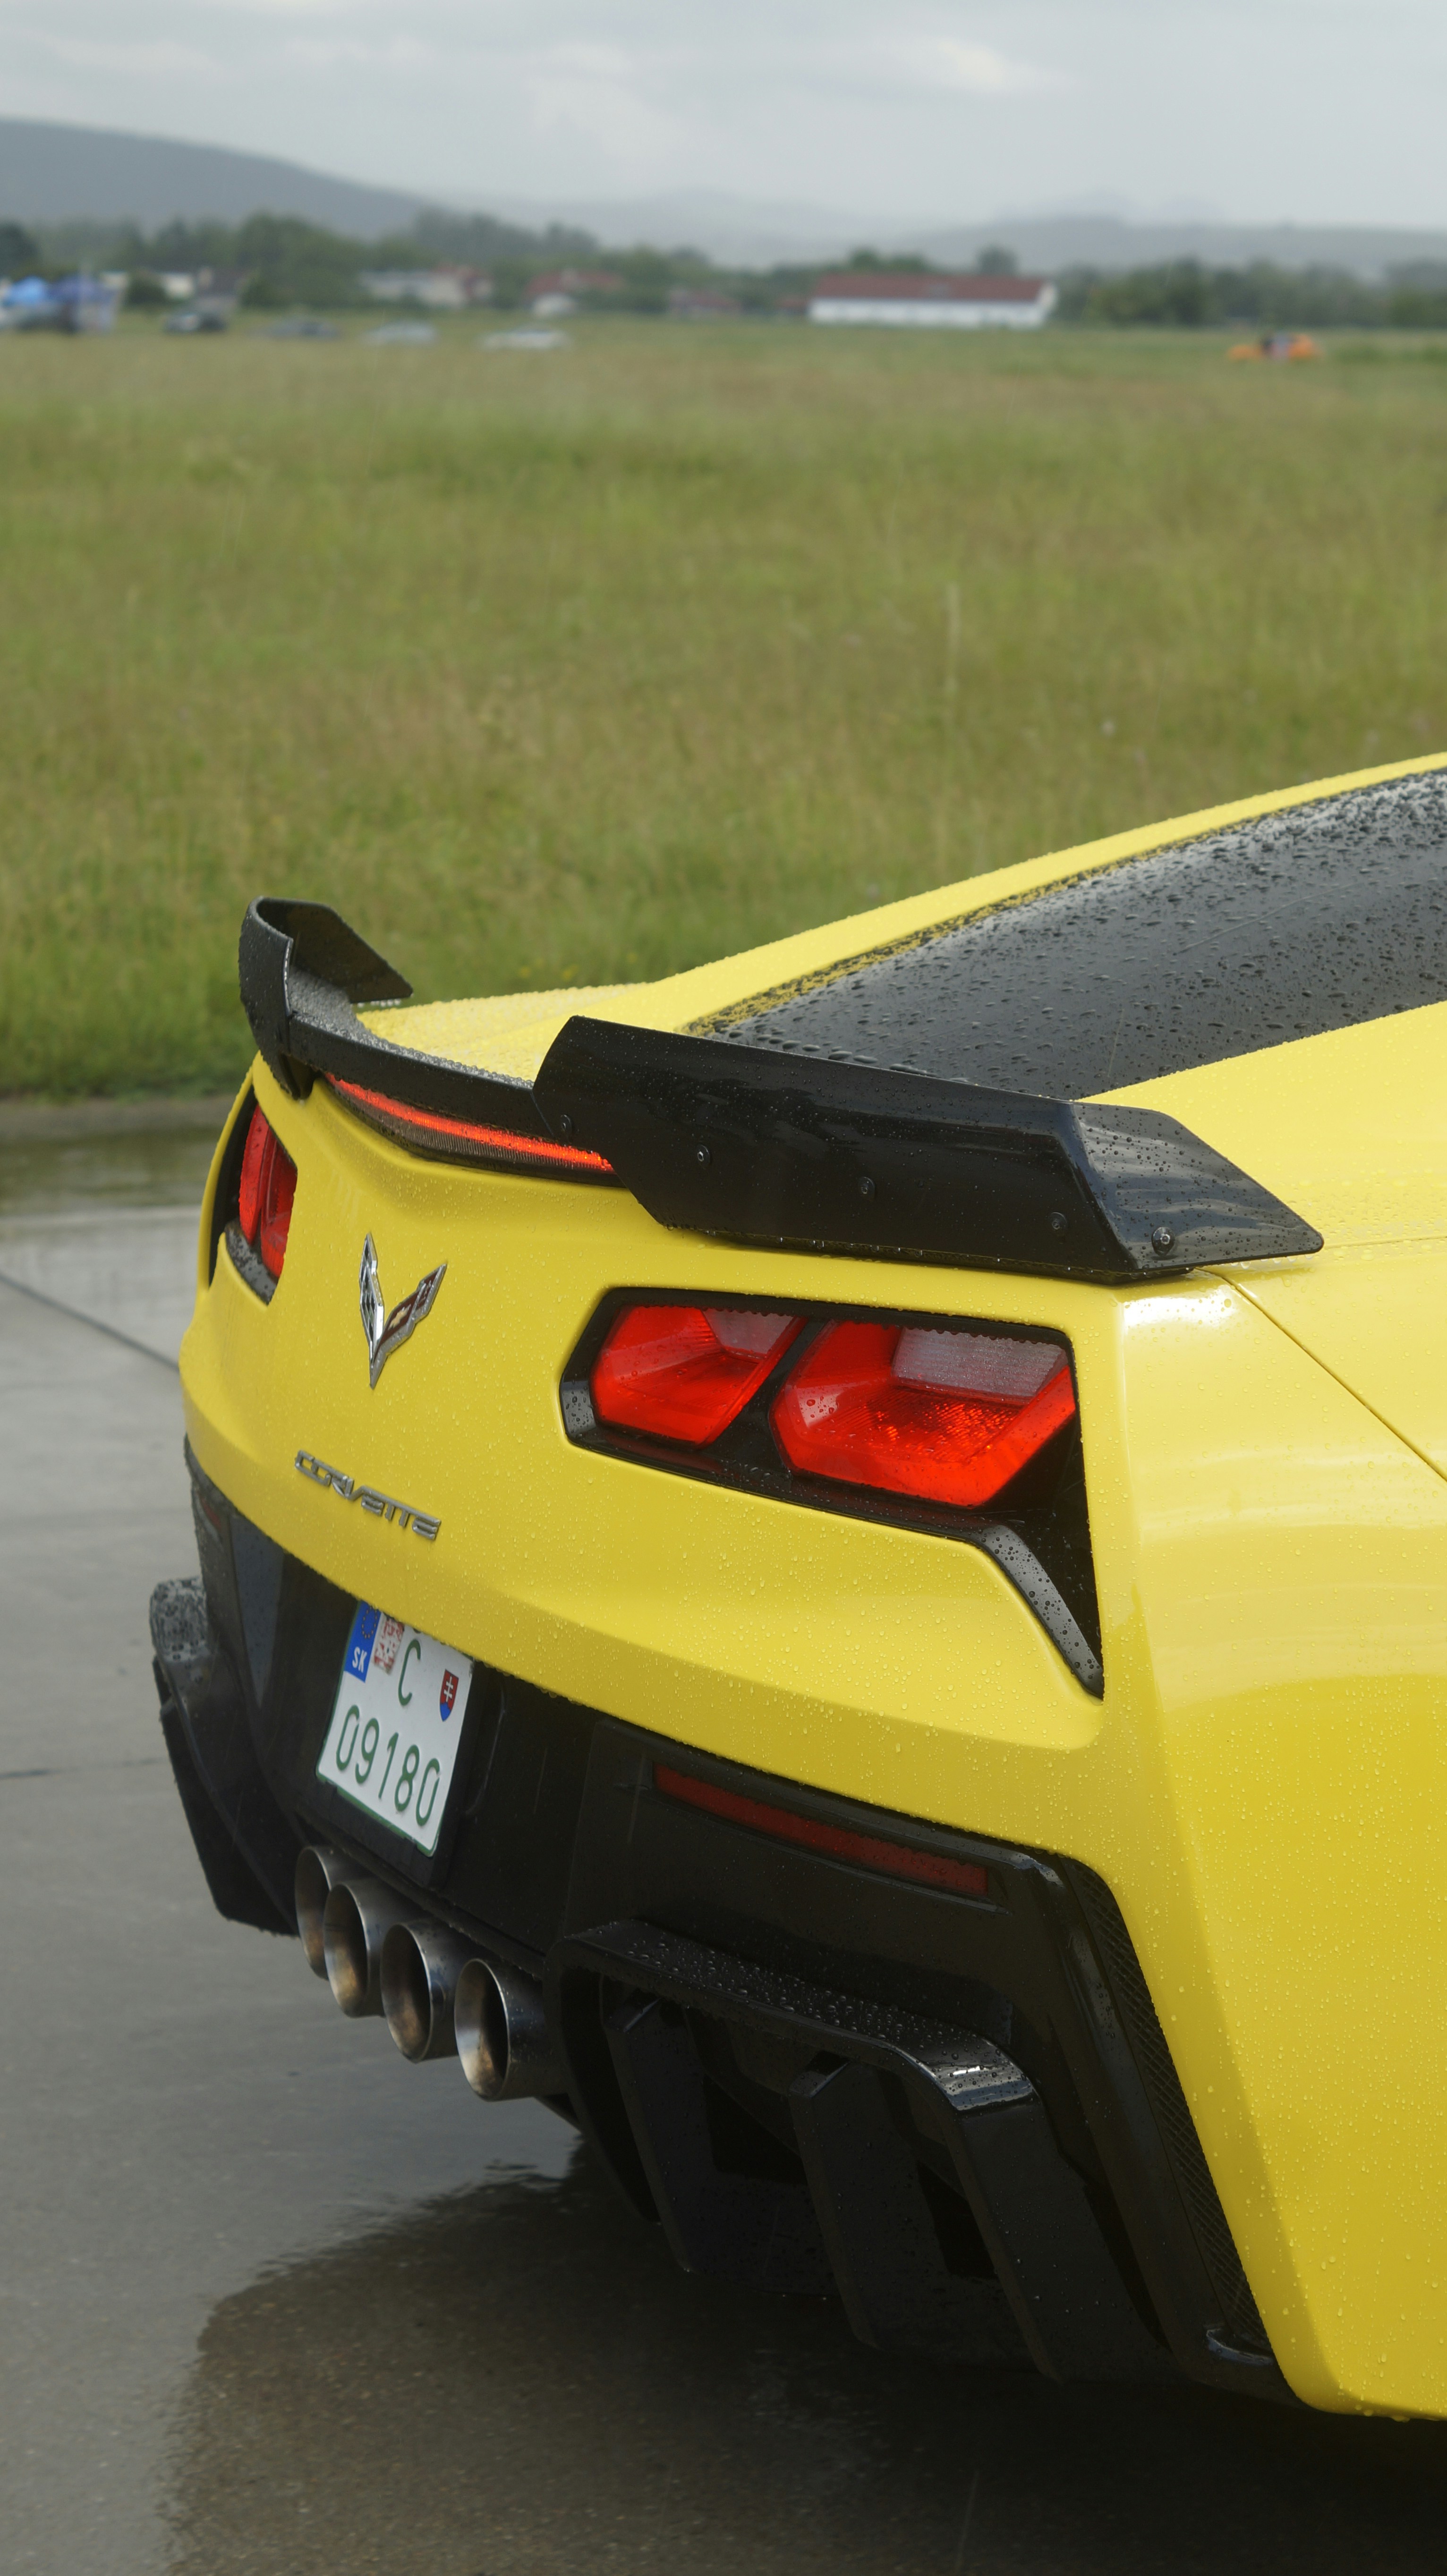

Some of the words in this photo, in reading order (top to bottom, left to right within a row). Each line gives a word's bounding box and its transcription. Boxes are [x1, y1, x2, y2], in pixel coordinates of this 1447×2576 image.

[295, 1450, 441, 1540] CORVETTE
[352, 1646, 367, 1673] SK
[398, 1639, 421, 1706] C
[336, 1705, 441, 1827] 09180
